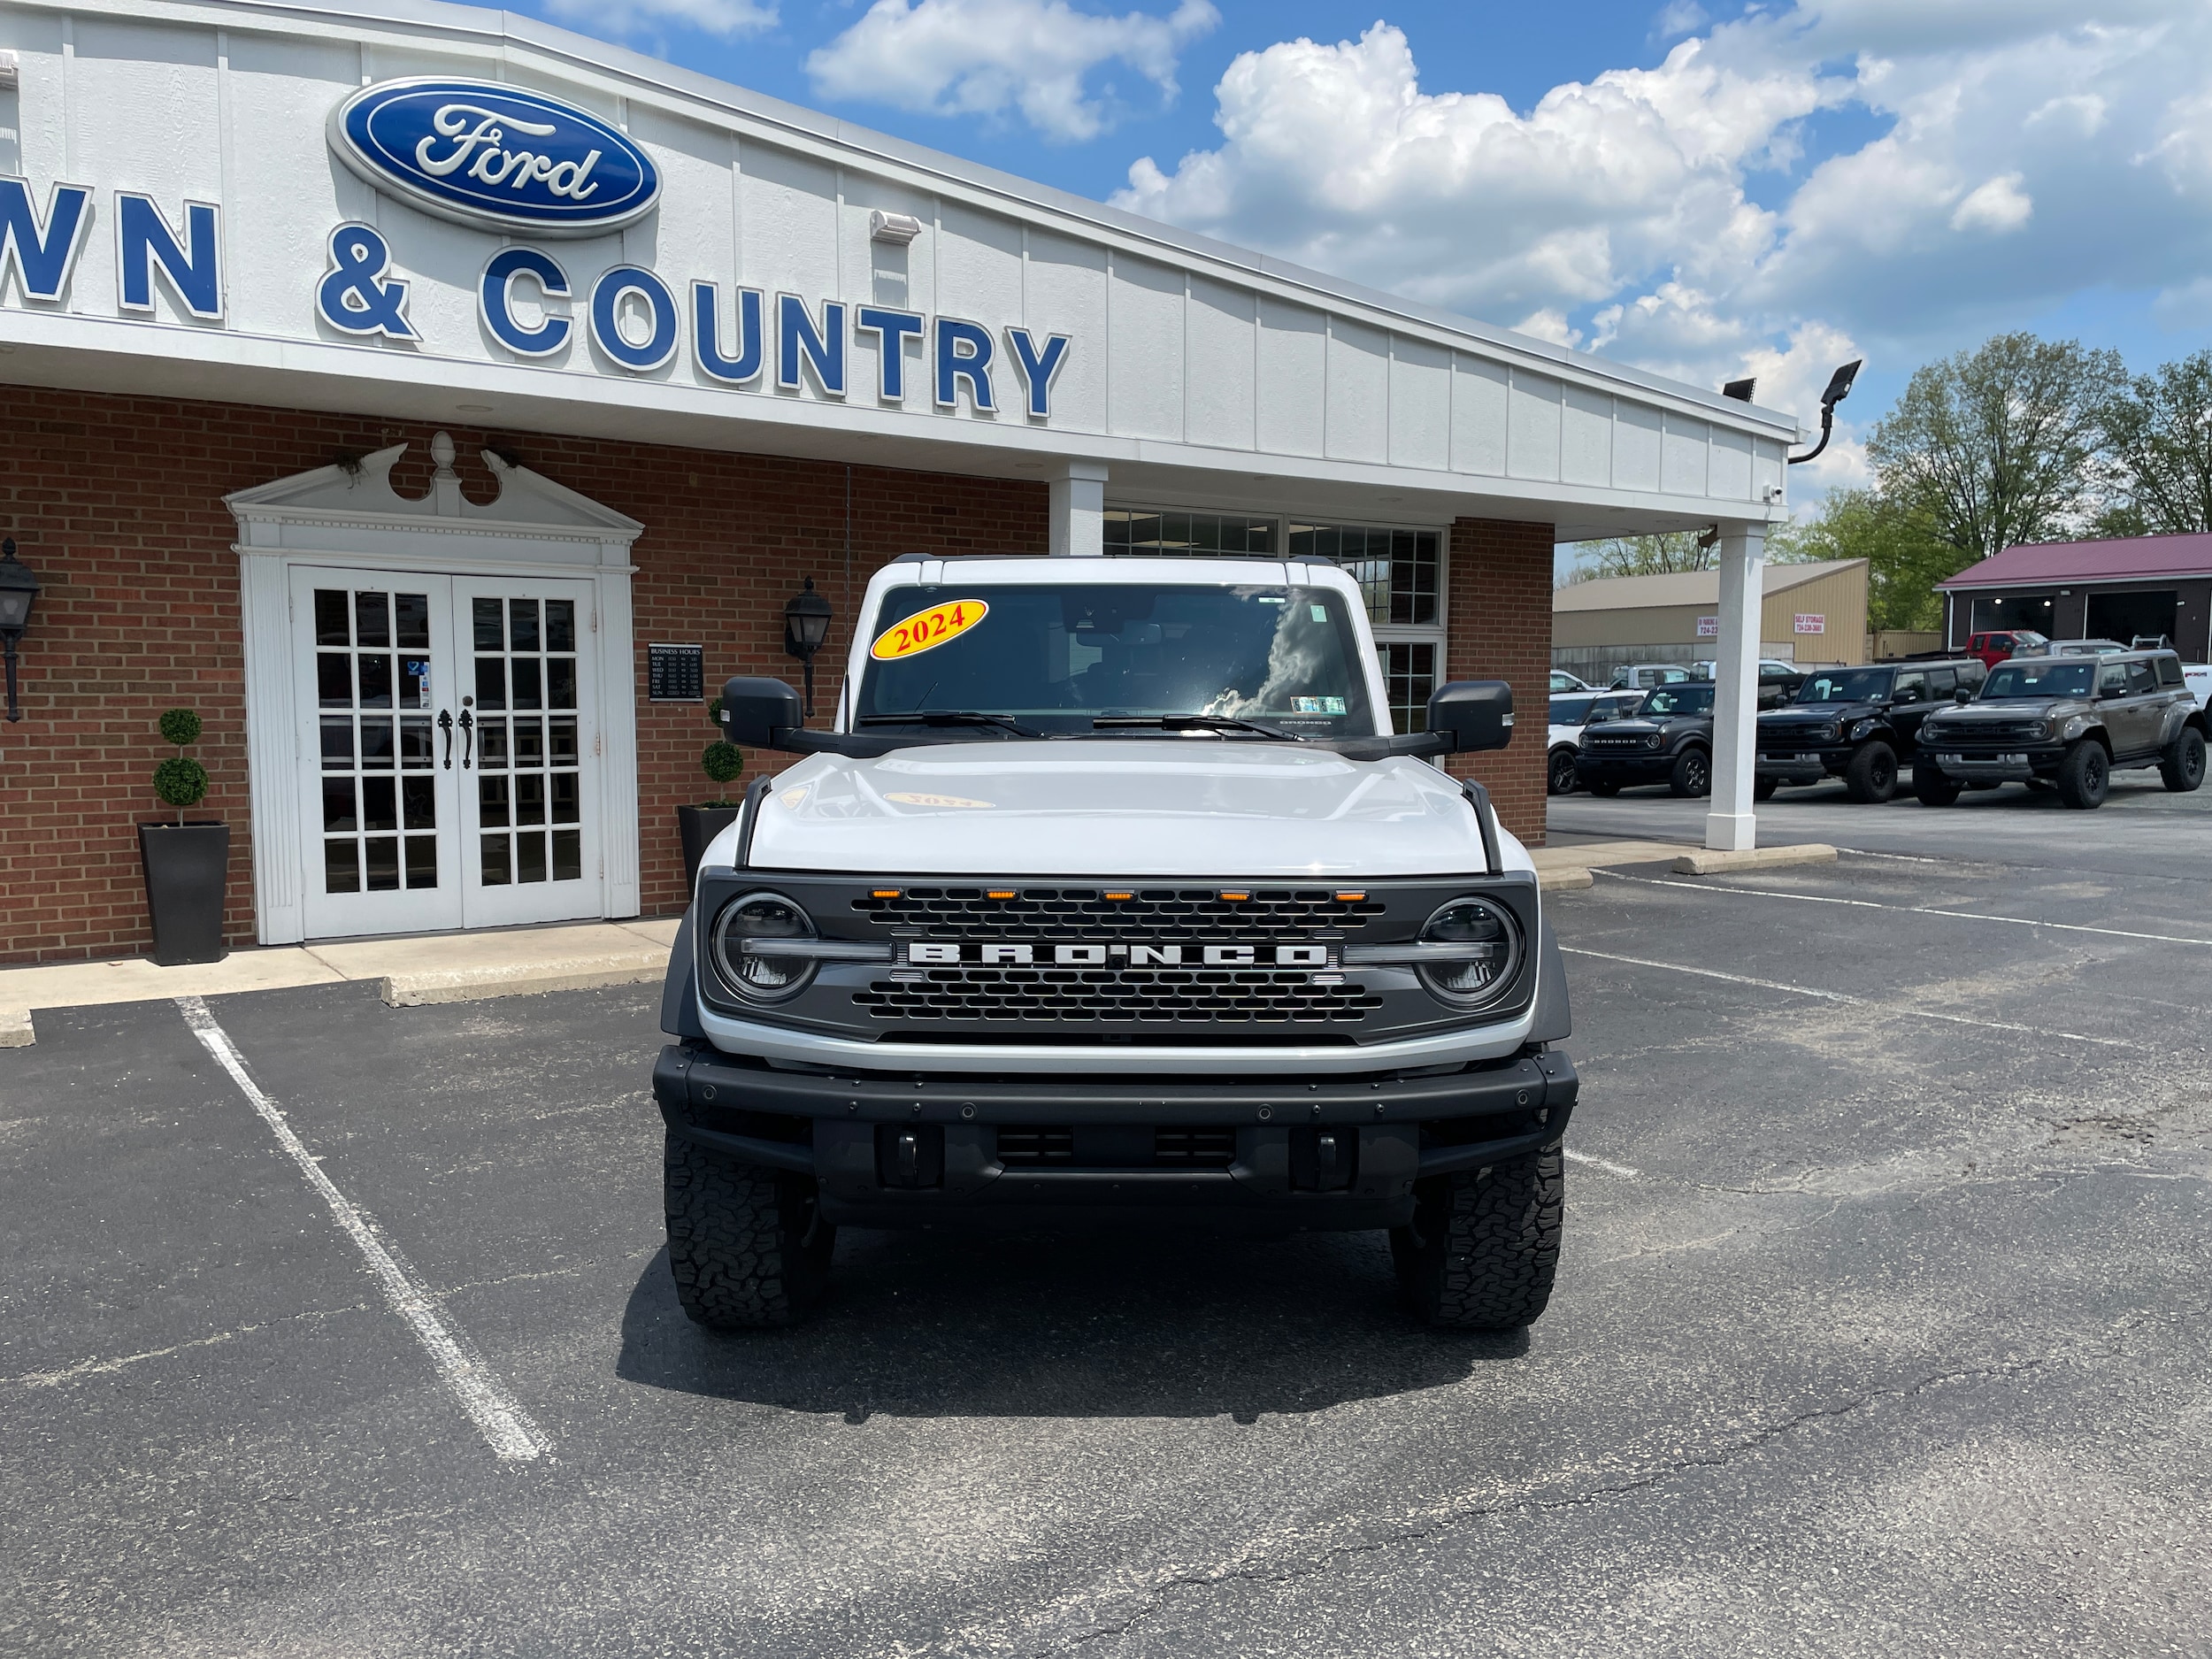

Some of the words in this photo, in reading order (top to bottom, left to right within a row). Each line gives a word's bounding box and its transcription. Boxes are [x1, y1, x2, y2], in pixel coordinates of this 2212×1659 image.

[415, 104, 602, 201] Ford
[315, 221, 424, 342] &
[477, 245, 1071, 418] COUNTRY
[894, 604, 965, 653] 2024
[909, 943, 1327, 965] BRONCO
